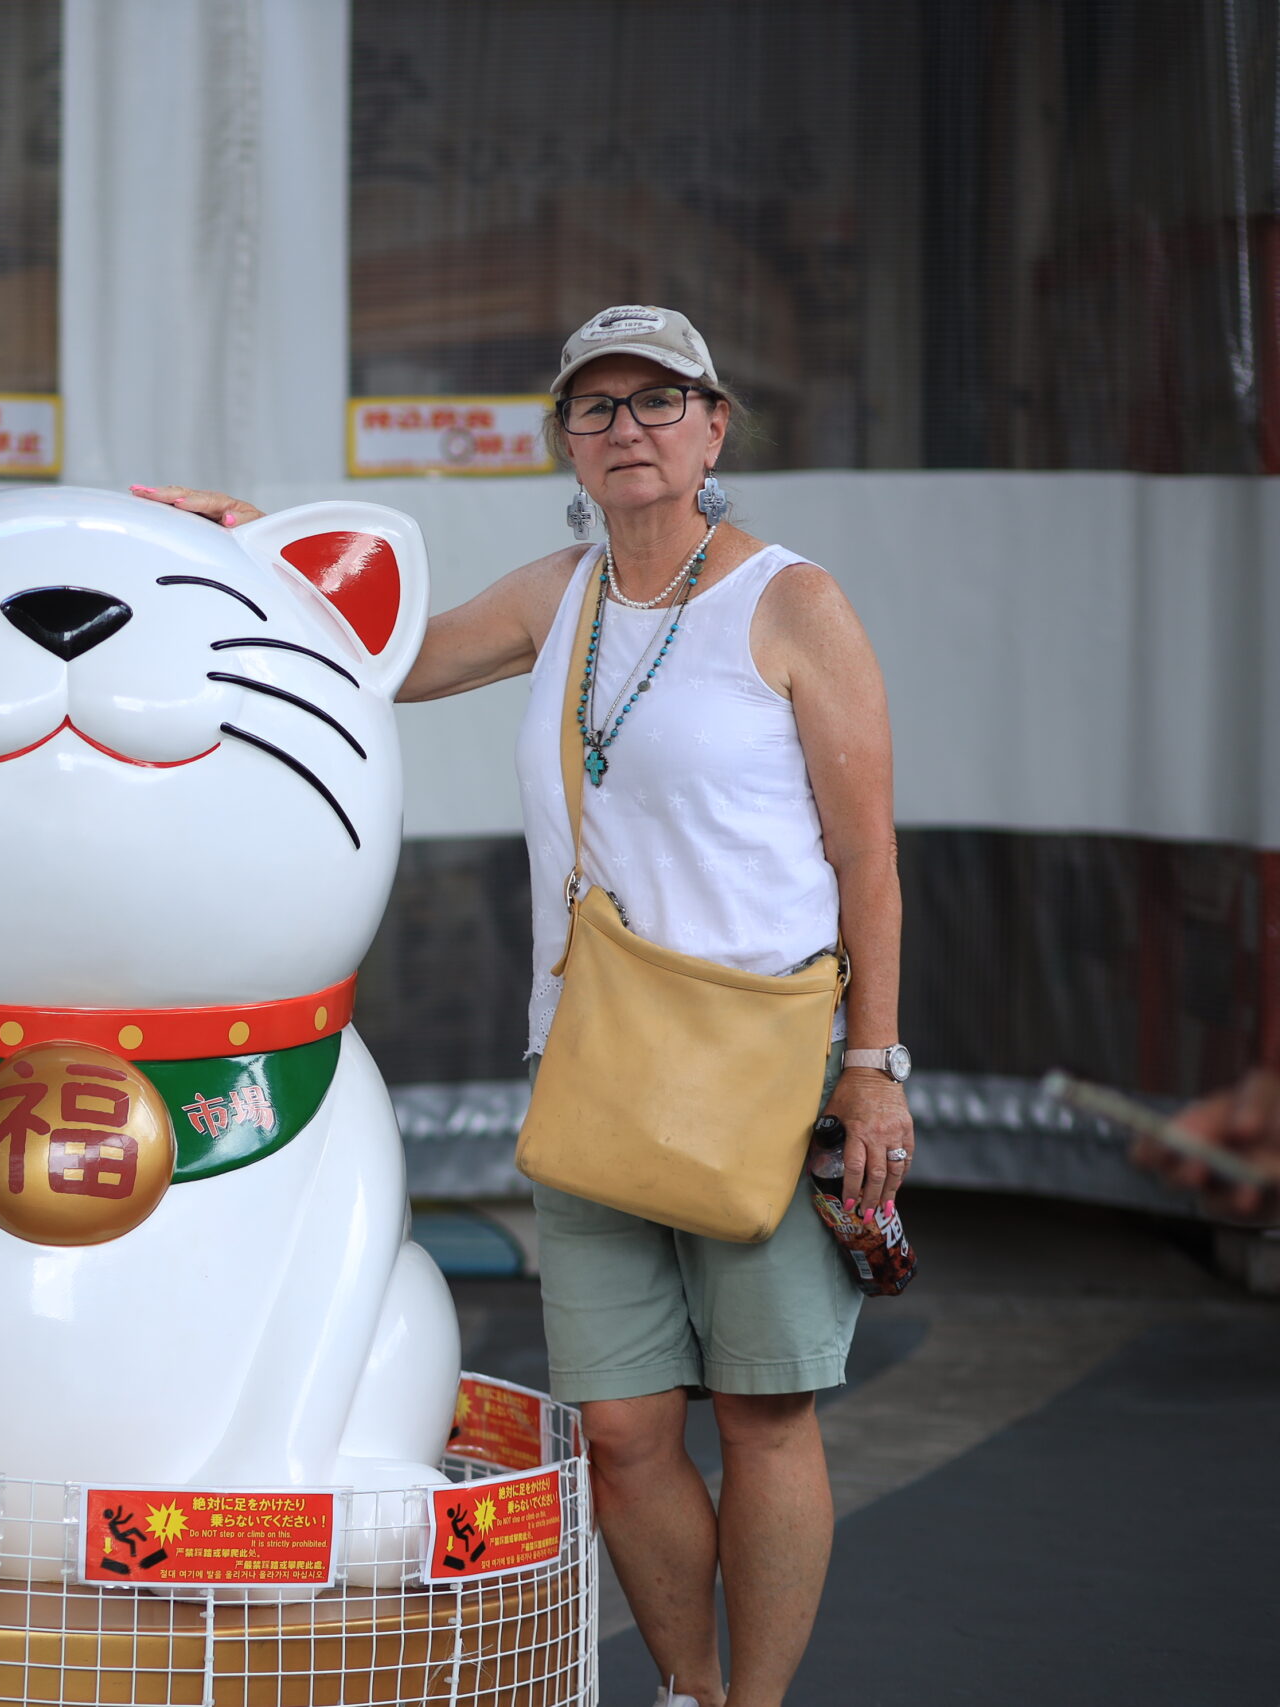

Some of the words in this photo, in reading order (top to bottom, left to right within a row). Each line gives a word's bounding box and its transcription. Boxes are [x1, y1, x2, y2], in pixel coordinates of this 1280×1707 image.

[181, 1085, 275, 1139] 市場
[498, 1477, 551, 1500] 絶対に足をかけたり
[192, 1497, 306, 1512] 絶対に足をかけたり
[210, 1513, 327, 1528] 乗らないでください！
[202, 1530, 217, 1538] NOT
[220, 1530, 235, 1539] step
[247, 1530, 265, 1538] climb
[267, 1540, 290, 1549] strictly
